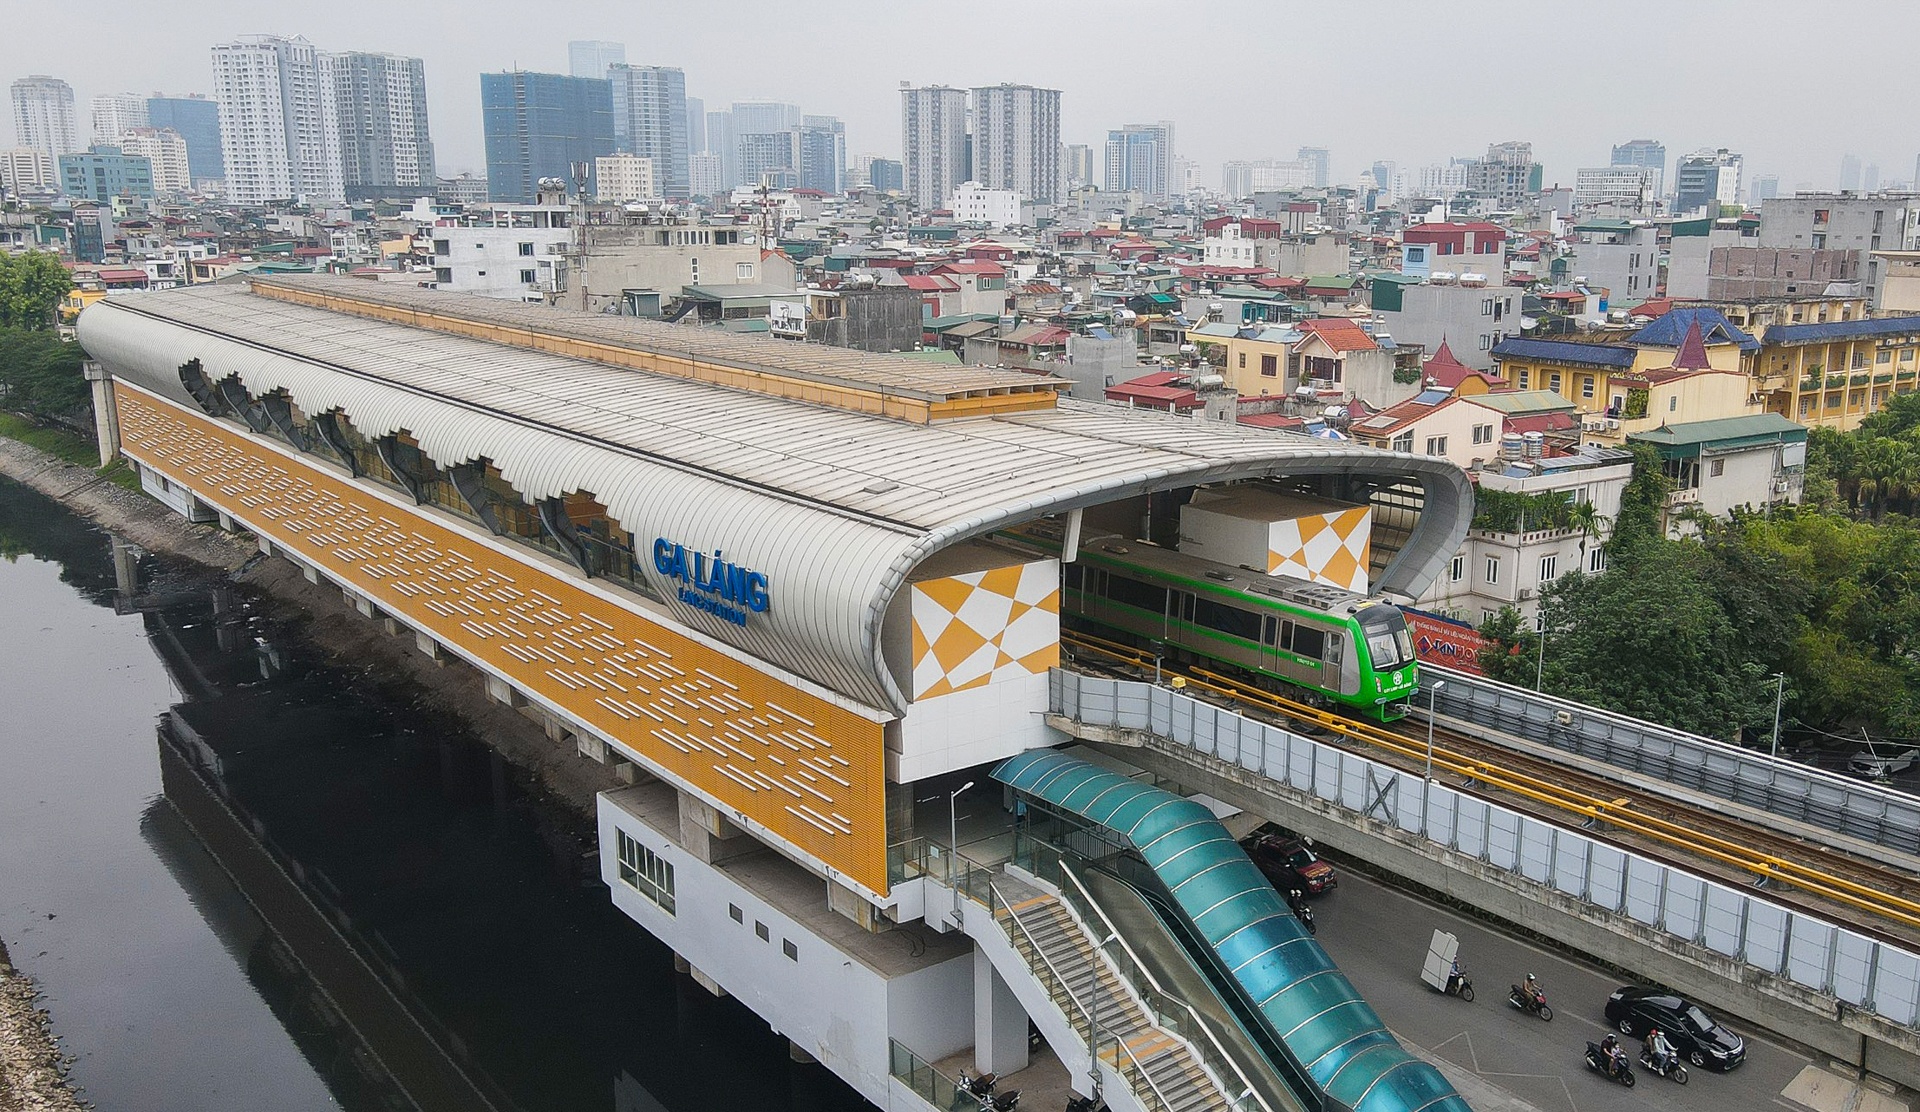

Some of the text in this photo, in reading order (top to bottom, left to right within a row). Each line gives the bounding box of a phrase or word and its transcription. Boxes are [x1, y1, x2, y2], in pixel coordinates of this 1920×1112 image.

[654, 537, 769, 612] GA LÁNG
[704, 598, 746, 627] STATION
